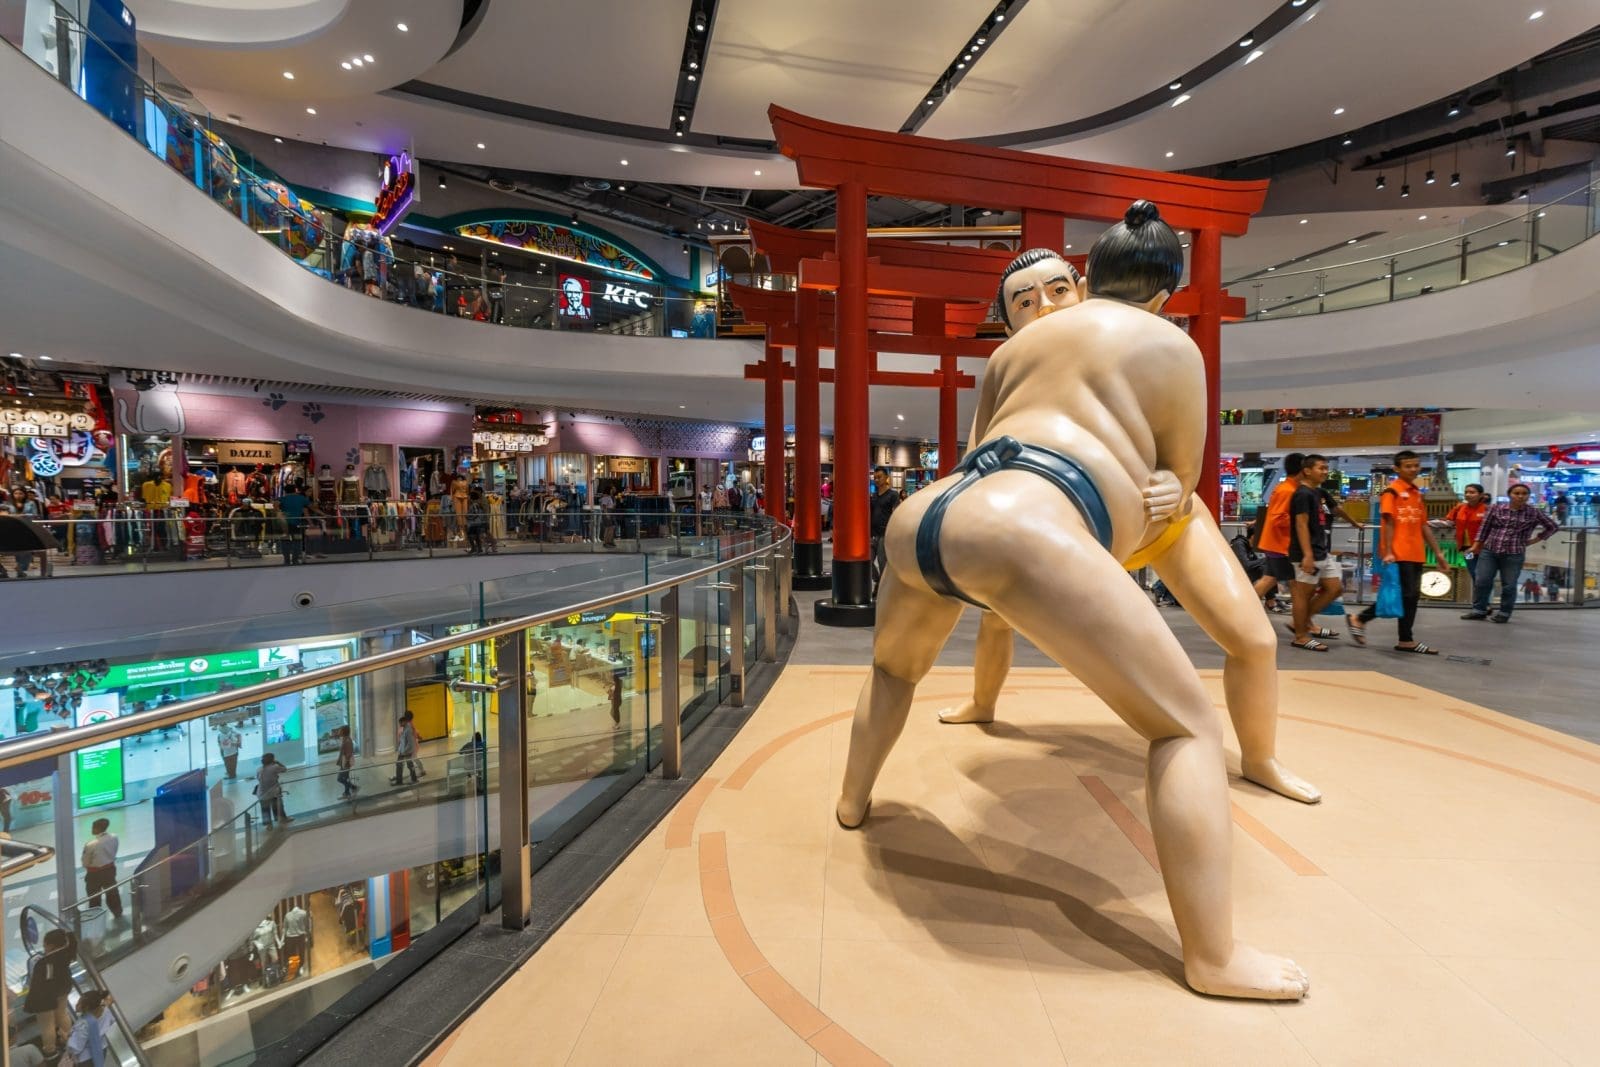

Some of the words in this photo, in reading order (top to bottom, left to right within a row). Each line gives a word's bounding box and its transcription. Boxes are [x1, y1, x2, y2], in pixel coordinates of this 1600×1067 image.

[602, 283, 649, 309] KFC
[230, 449, 272, 459] DAZZLE
[268, 647, 287, 662] K
